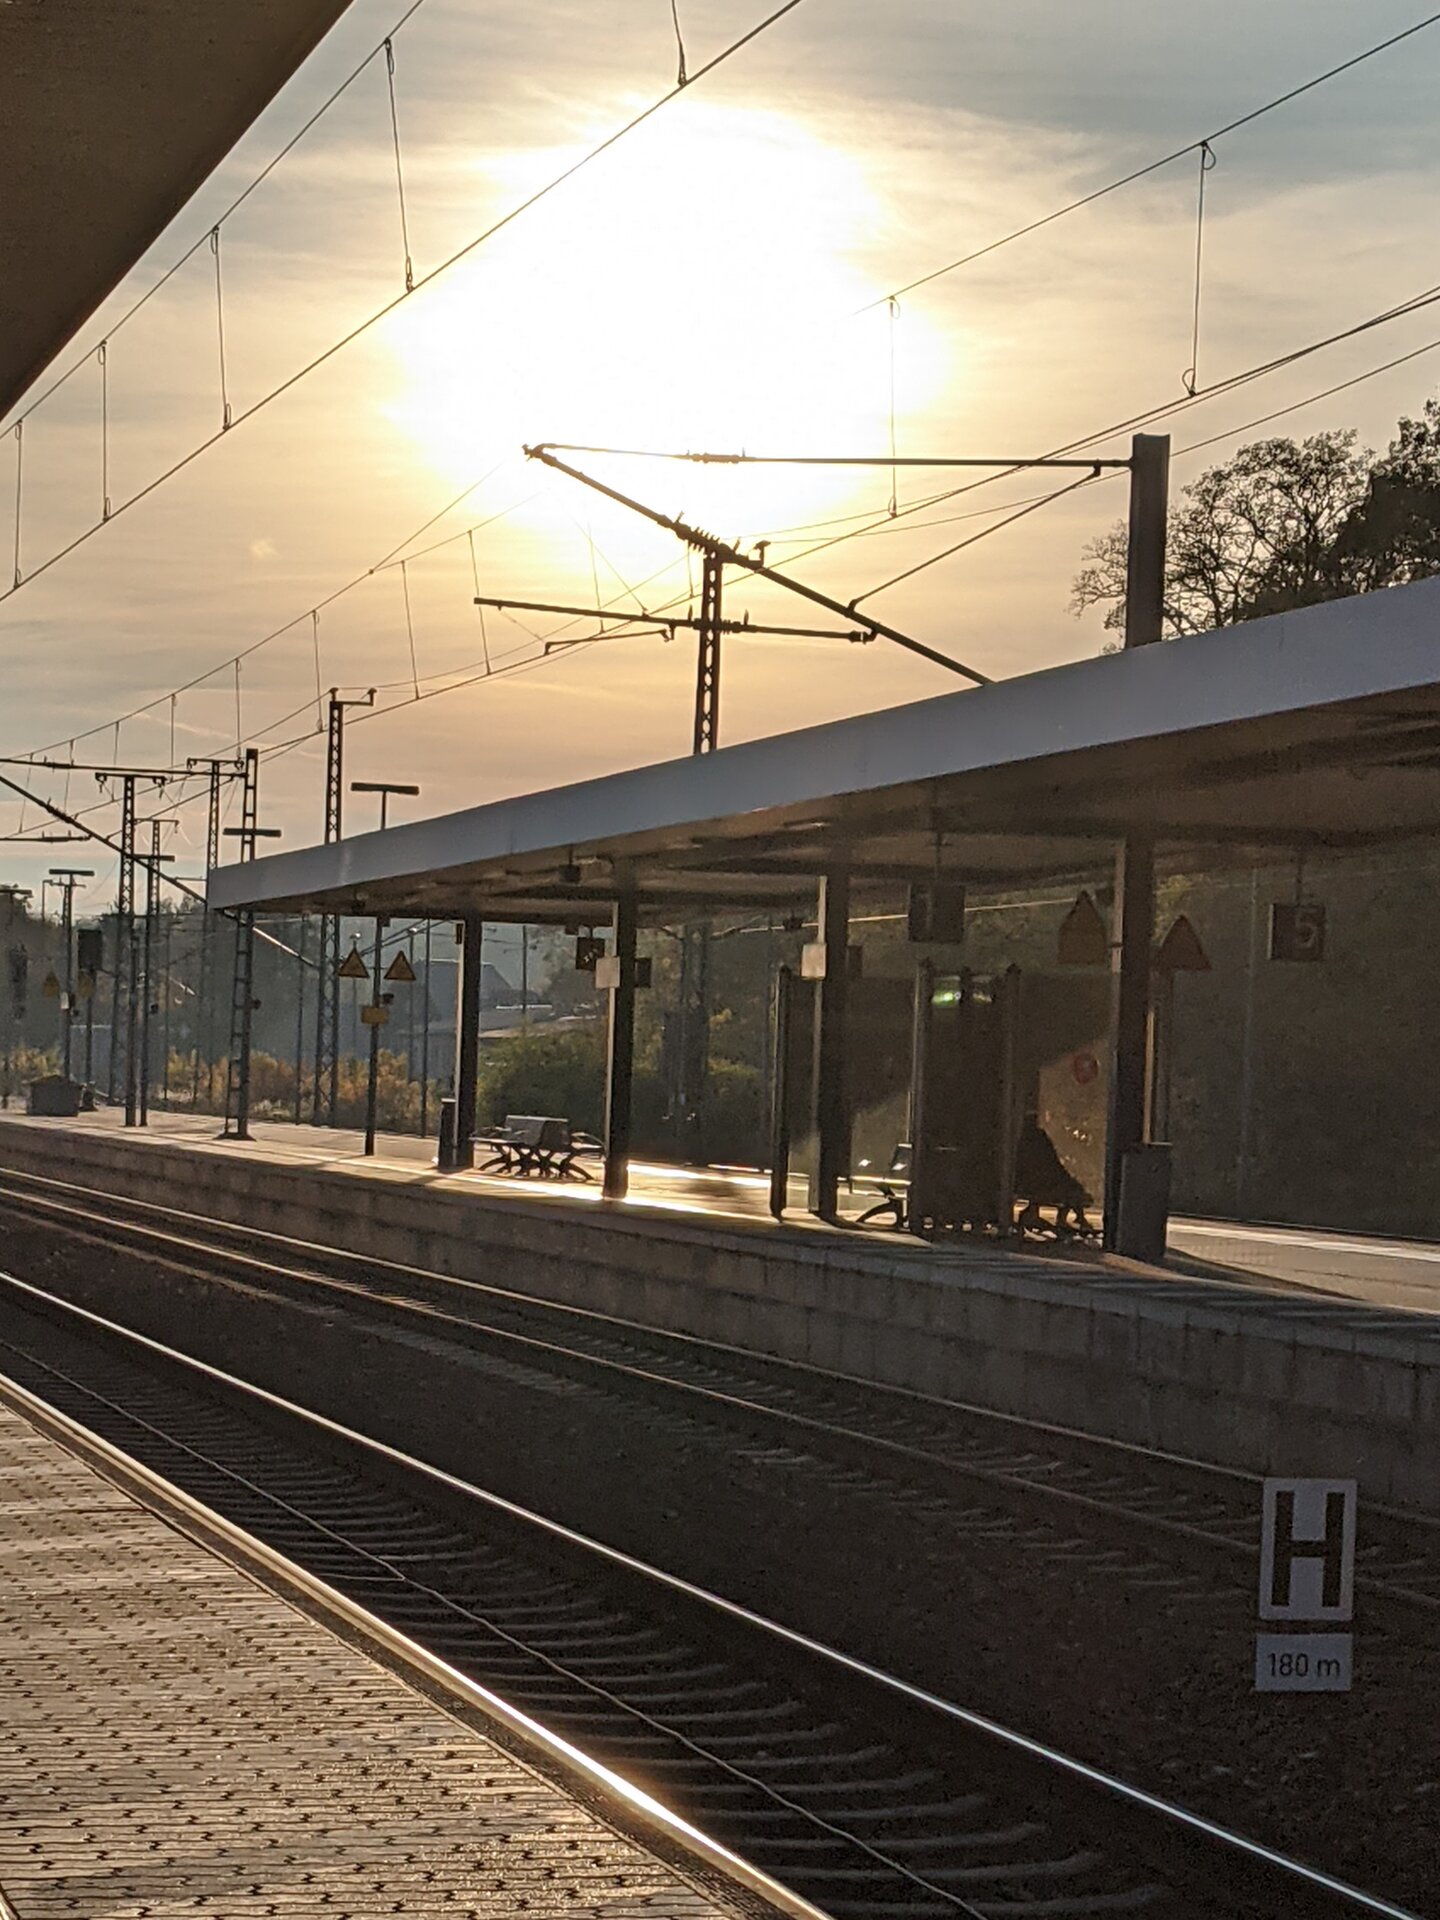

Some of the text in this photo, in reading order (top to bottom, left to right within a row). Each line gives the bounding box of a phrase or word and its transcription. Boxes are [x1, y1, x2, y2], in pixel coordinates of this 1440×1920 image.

[1270, 1490, 1346, 1608] H
[1267, 1652, 1340, 1677] 180 m
